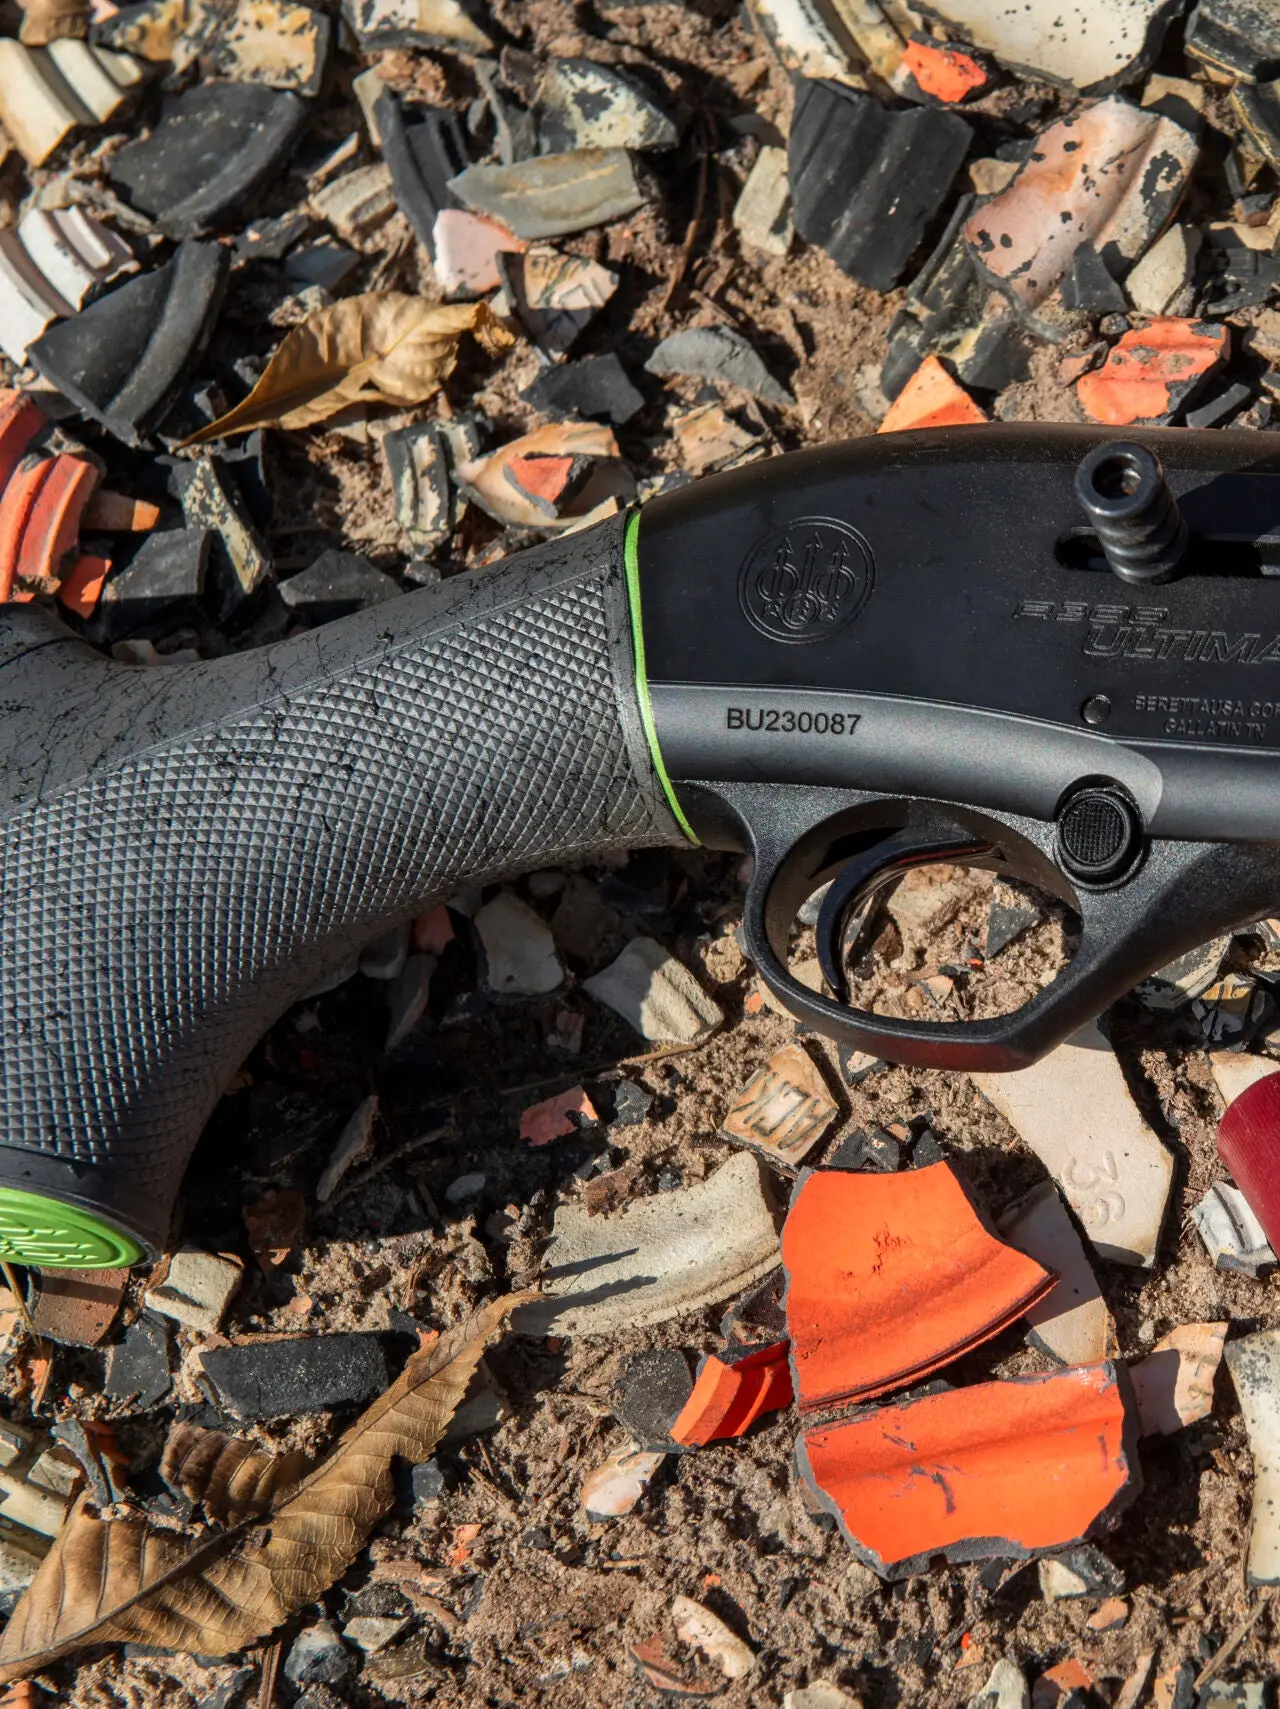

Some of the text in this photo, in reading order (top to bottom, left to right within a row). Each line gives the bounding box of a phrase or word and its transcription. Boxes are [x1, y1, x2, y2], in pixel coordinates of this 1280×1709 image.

[727, 707, 862, 736] BU230087
[1164, 717, 1267, 740] GALLATIN TN
